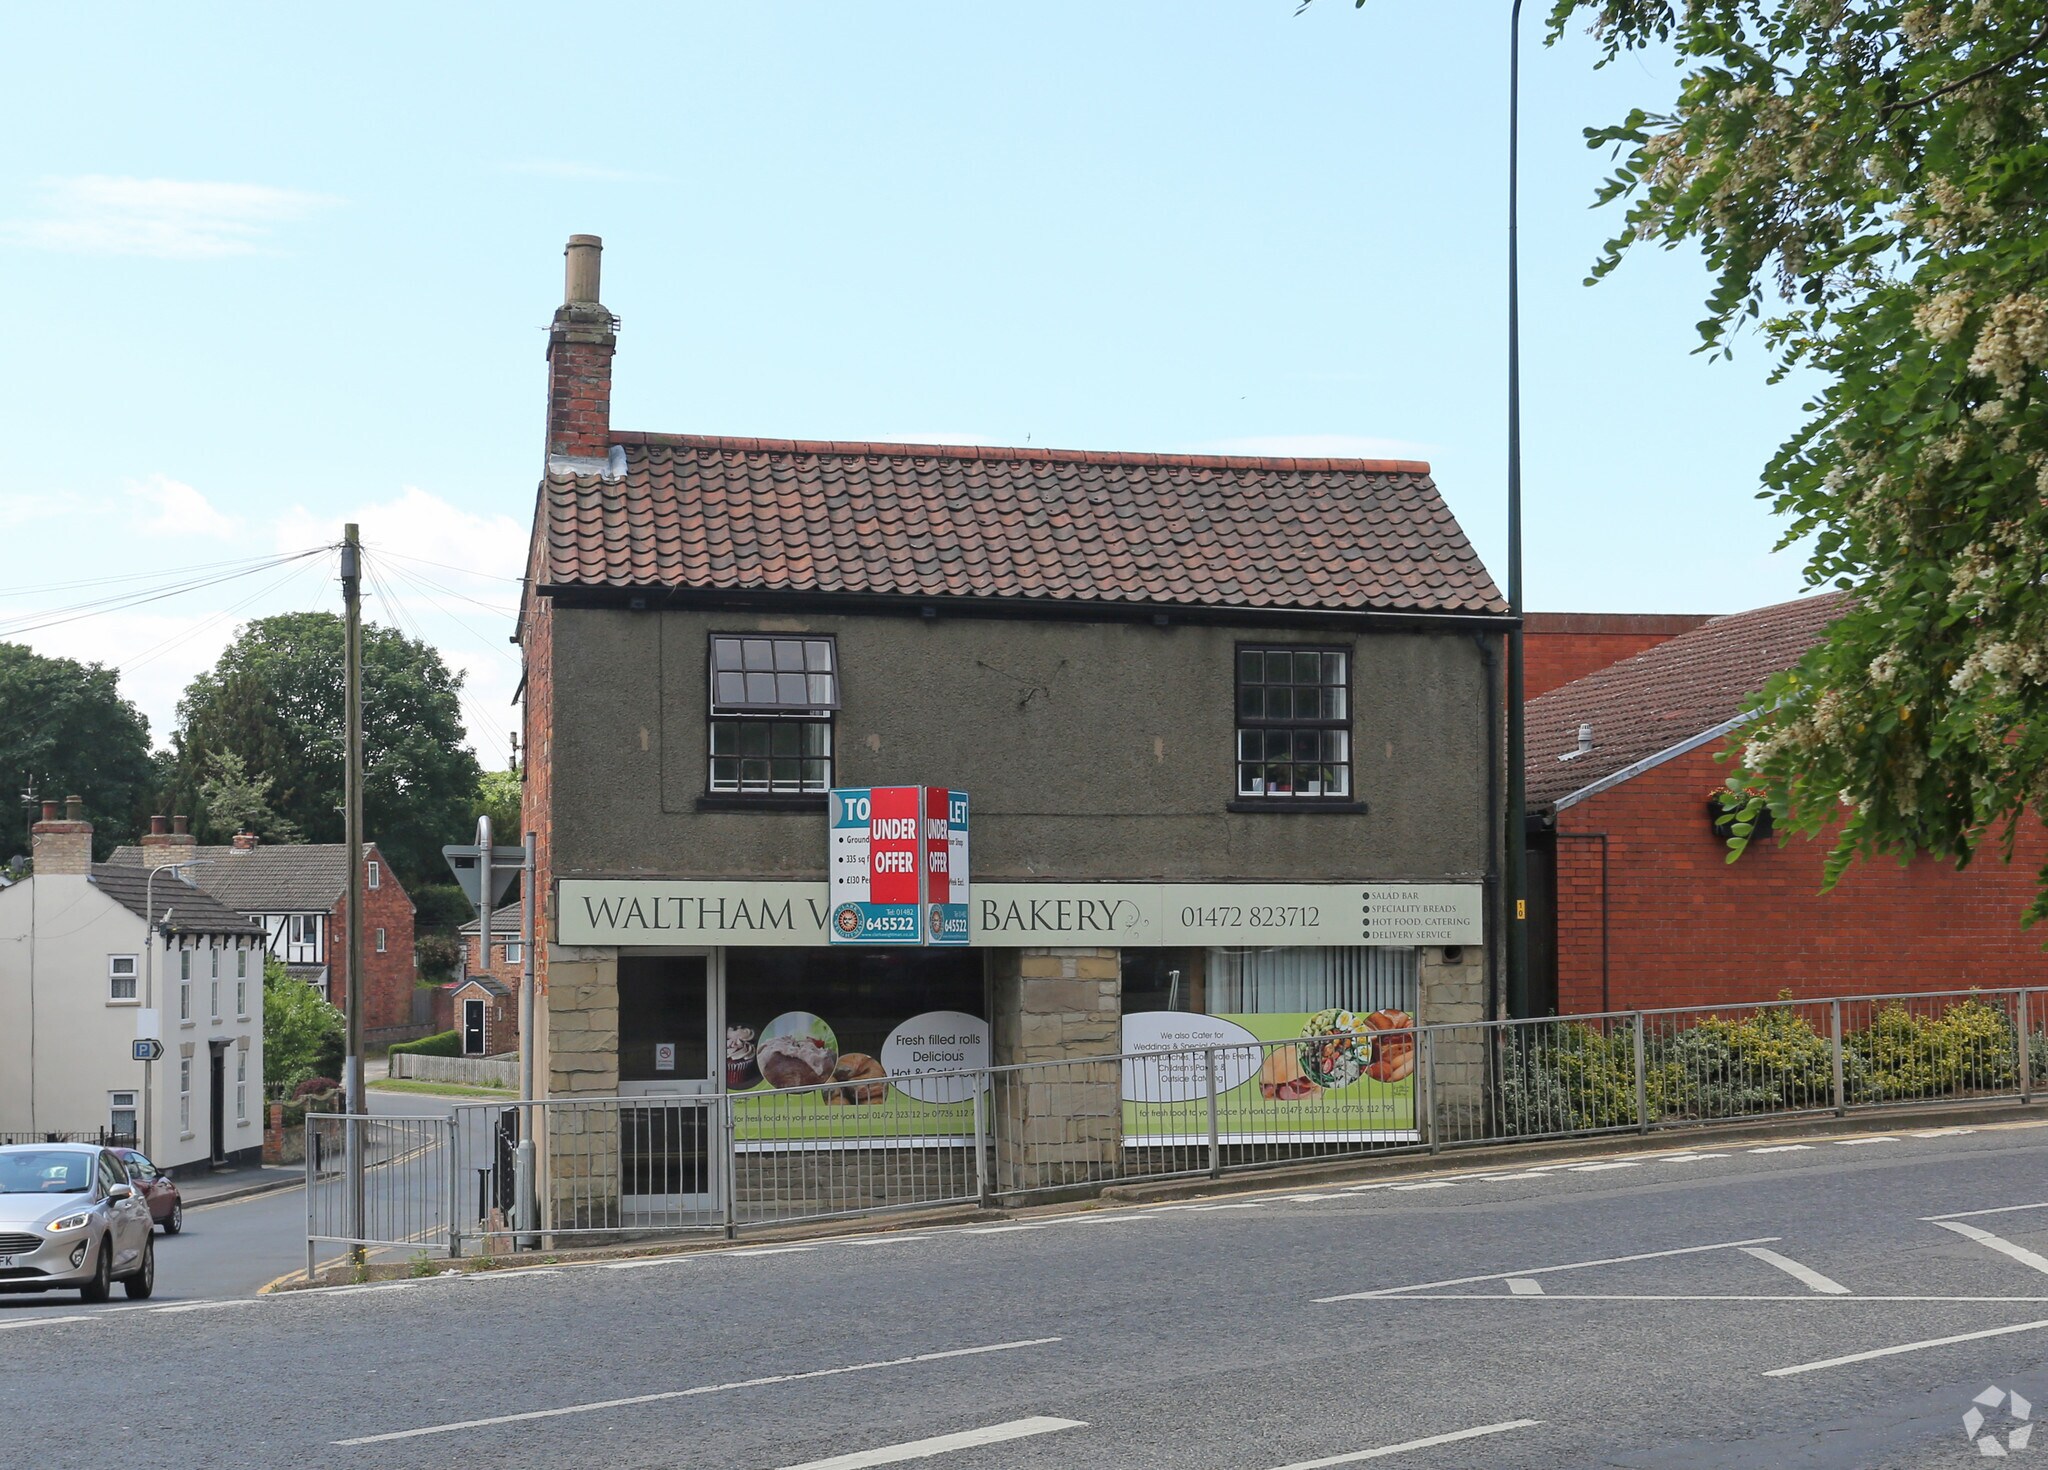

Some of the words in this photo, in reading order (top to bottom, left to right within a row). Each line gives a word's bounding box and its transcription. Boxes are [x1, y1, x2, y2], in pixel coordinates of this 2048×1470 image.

[844, 797, 871, 821] TO
[949, 800, 967, 824] LET
[872, 818, 916, 840] UNDER
[927, 818, 948, 840] UNDER
[846, 835, 870, 844] Ground
[846, 854, 857, 863] 335
[858, 856, 866, 865] sq
[874, 851, 914, 873] OFFER
[929, 851, 948, 873] OFFER
[846, 876, 860, 884] £130
[1371, 892, 1400, 900] SALAD
[1402, 892, 1419, 900] BAR
[581, 896, 797, 930] WALTHAM
[895, 908, 914, 916] 01482
[980, 899, 1123, 931] BAKERY
[1371, 905, 1421, 913] SPECIALITY
[1423, 905, 1457, 913] BREADS
[1181, 906, 1243, 928] 01472
[1249, 906, 1320, 928] 823712
[1372, 918, 1394, 926] HOT
[1424, 917, 1471, 926] CATERING
[866, 917, 914, 931] 645522
[944, 919, 967, 932] 645522
[1372, 931, 1414, 939] DELIVERY
[1416, 931, 1452, 939] SERVICE
[896, 1034, 925, 1046] Fresh
[928, 1034, 956, 1045] filled
[959, 1034, 981, 1045] rolls
[1160, 1032, 1173, 1040] We
[1174, 1031, 1190, 1040] also
[1191, 1031, 1213, 1040] Cater
[1214, 1031, 1225, 1039] for
[139, 1044, 149, 1056] P
[912, 1051, 965, 1062] Delicious
[896, 1110, 921, 1118] 82312
